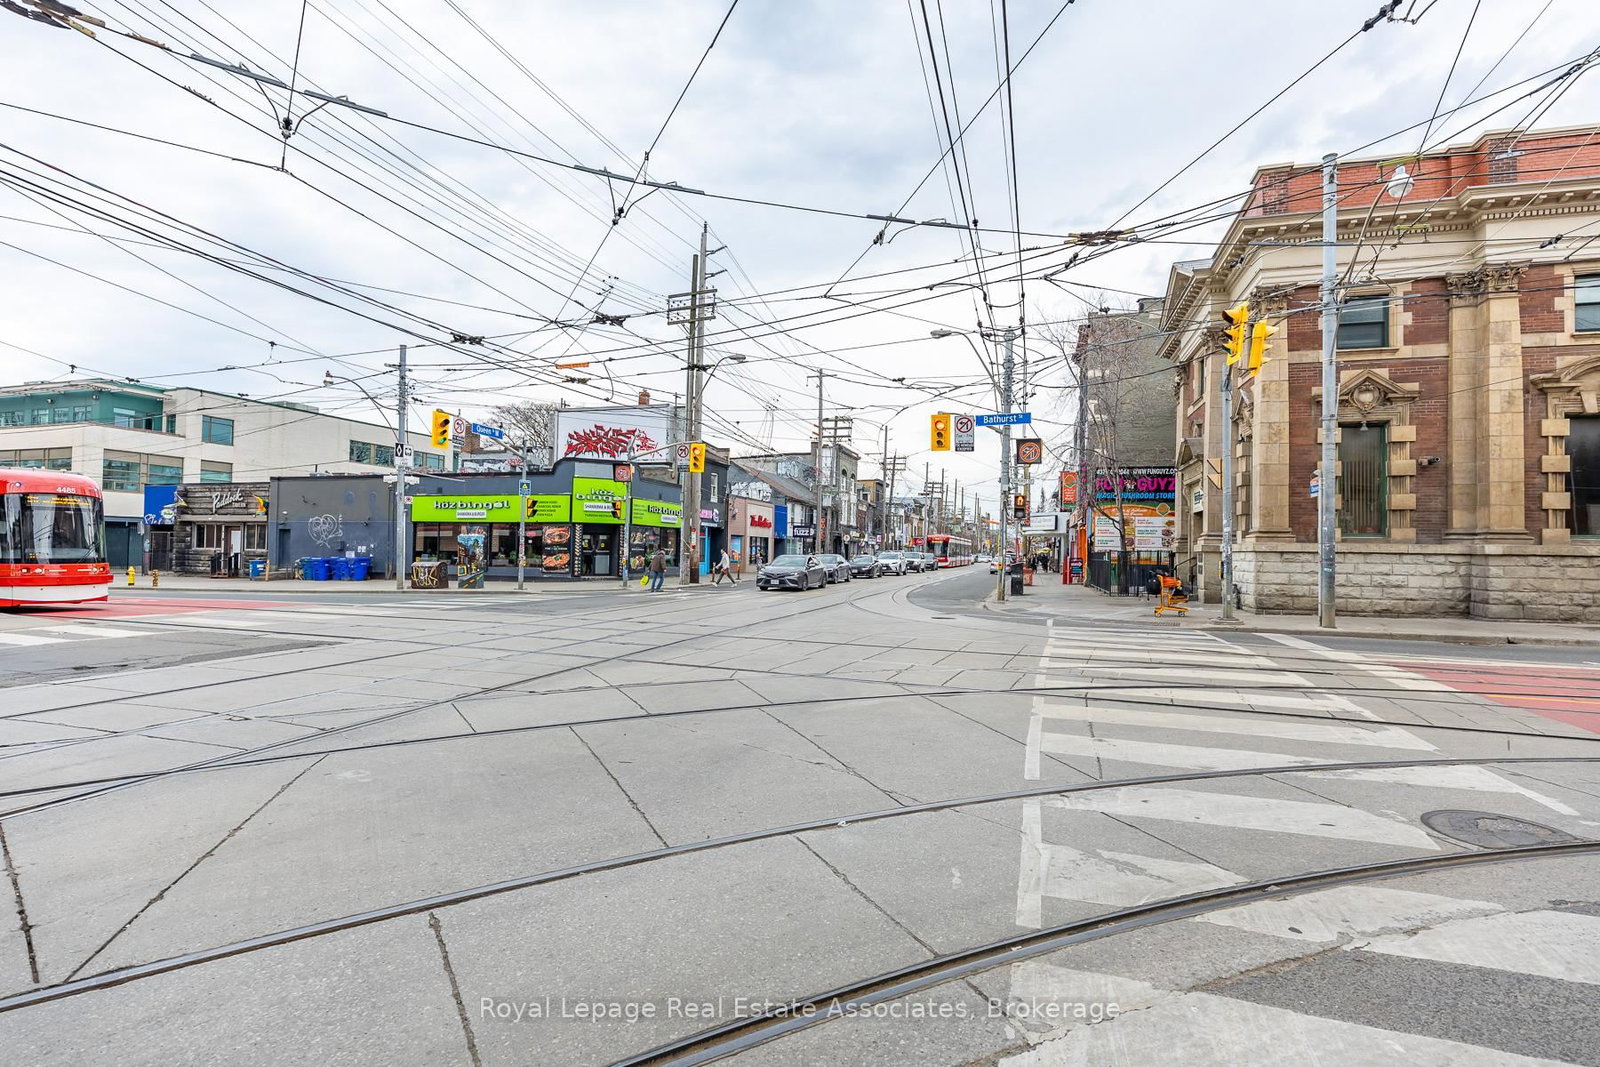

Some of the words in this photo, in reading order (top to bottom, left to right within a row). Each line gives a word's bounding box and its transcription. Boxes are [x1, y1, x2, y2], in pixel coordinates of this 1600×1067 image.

[983, 414, 1017, 424] Bathurst
[476, 425, 492, 435] Queen
[1137, 477, 1176, 491] GUYZ
[212, 488, 244, 514] Paddock
[794, 527, 810, 536] fuzz
